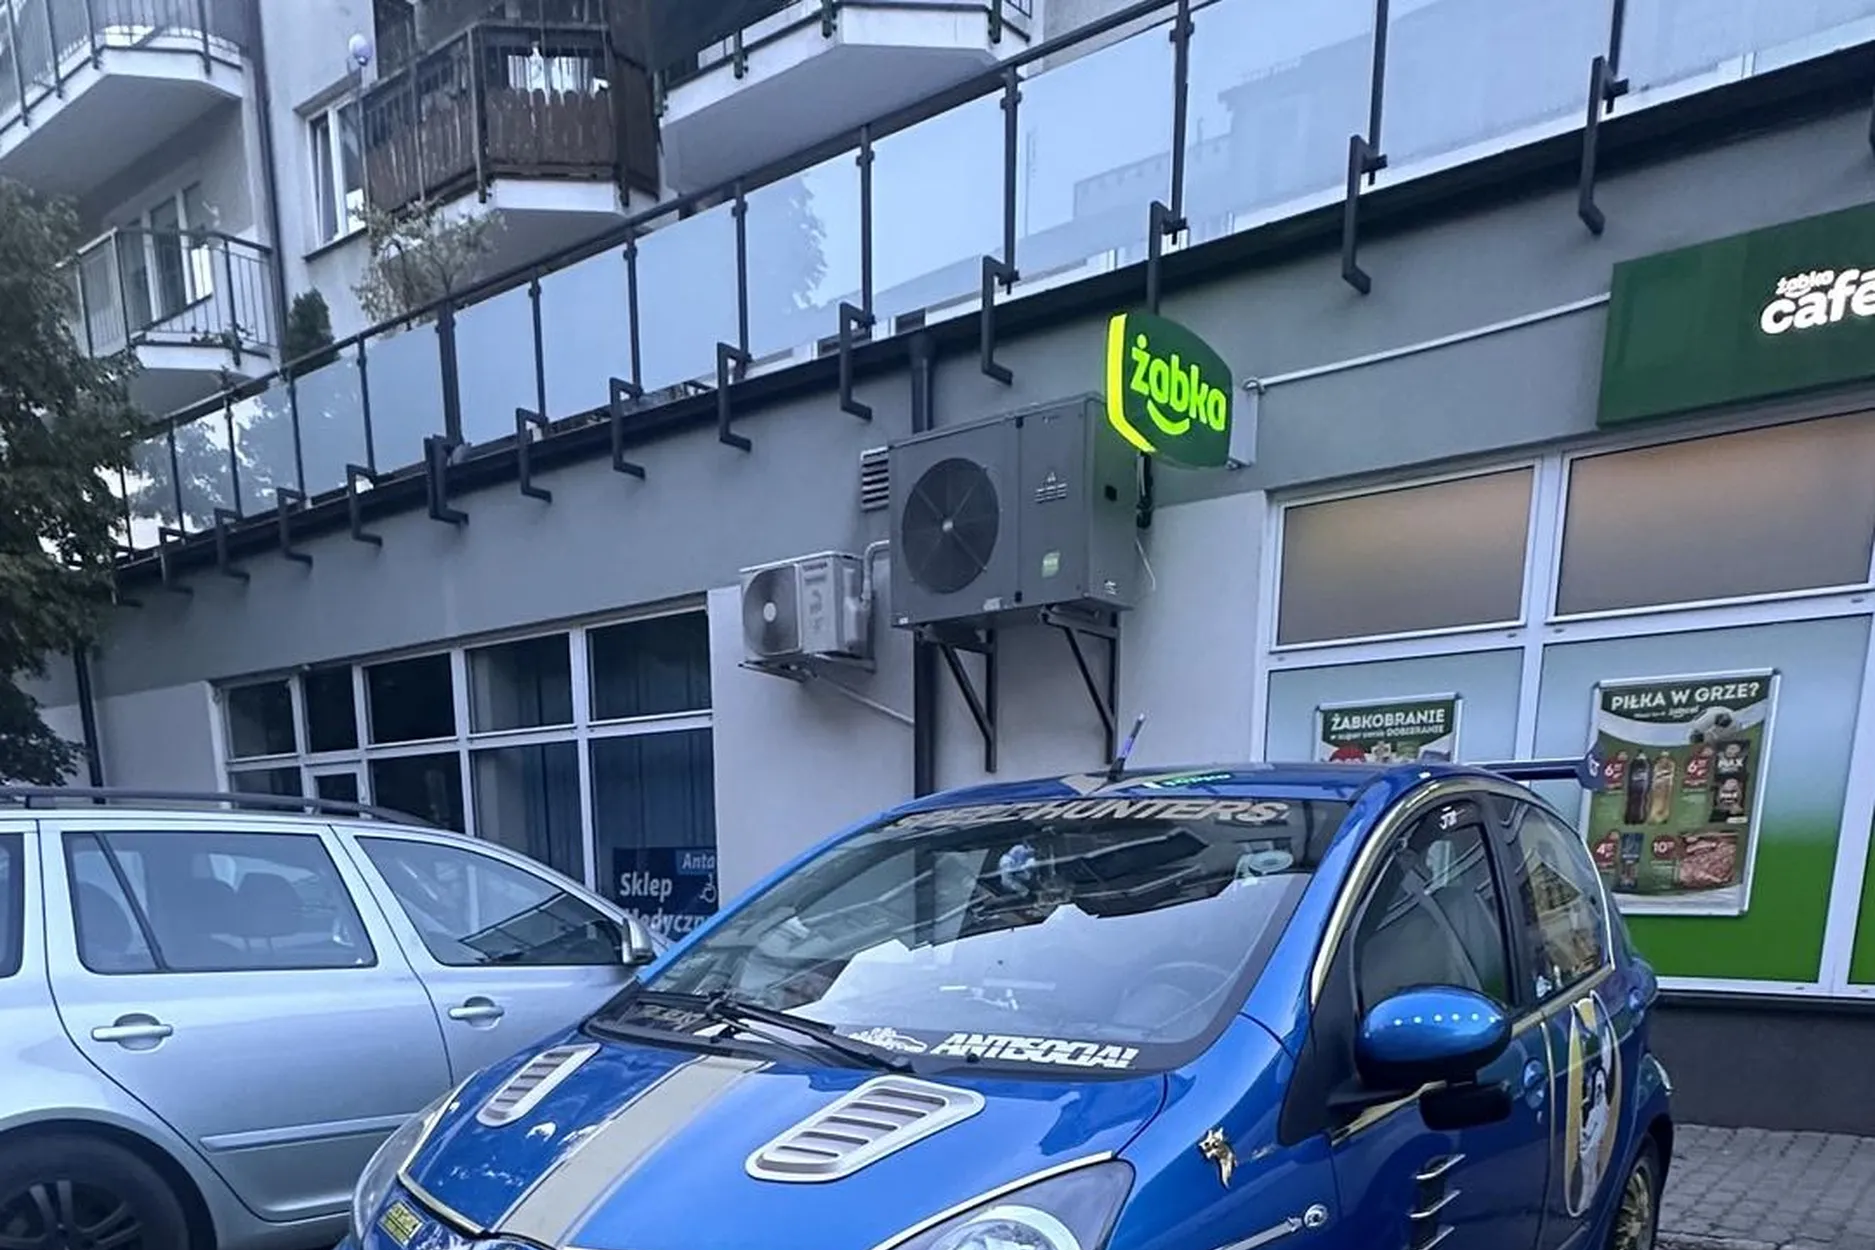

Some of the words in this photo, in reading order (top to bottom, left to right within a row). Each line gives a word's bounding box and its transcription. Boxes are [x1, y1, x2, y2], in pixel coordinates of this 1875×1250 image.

[1130, 333, 1227, 436] żabka
[1611, 691, 1666, 710] PIŁKA
[1670, 689, 1691, 705] W
[1694, 681, 1761, 702] GRZE?
[1331, 709, 1445, 731] ŻABKOBRANIE
[893, 799, 1288, 832] HUNTERS
[619, 872, 673, 903] Sklep
